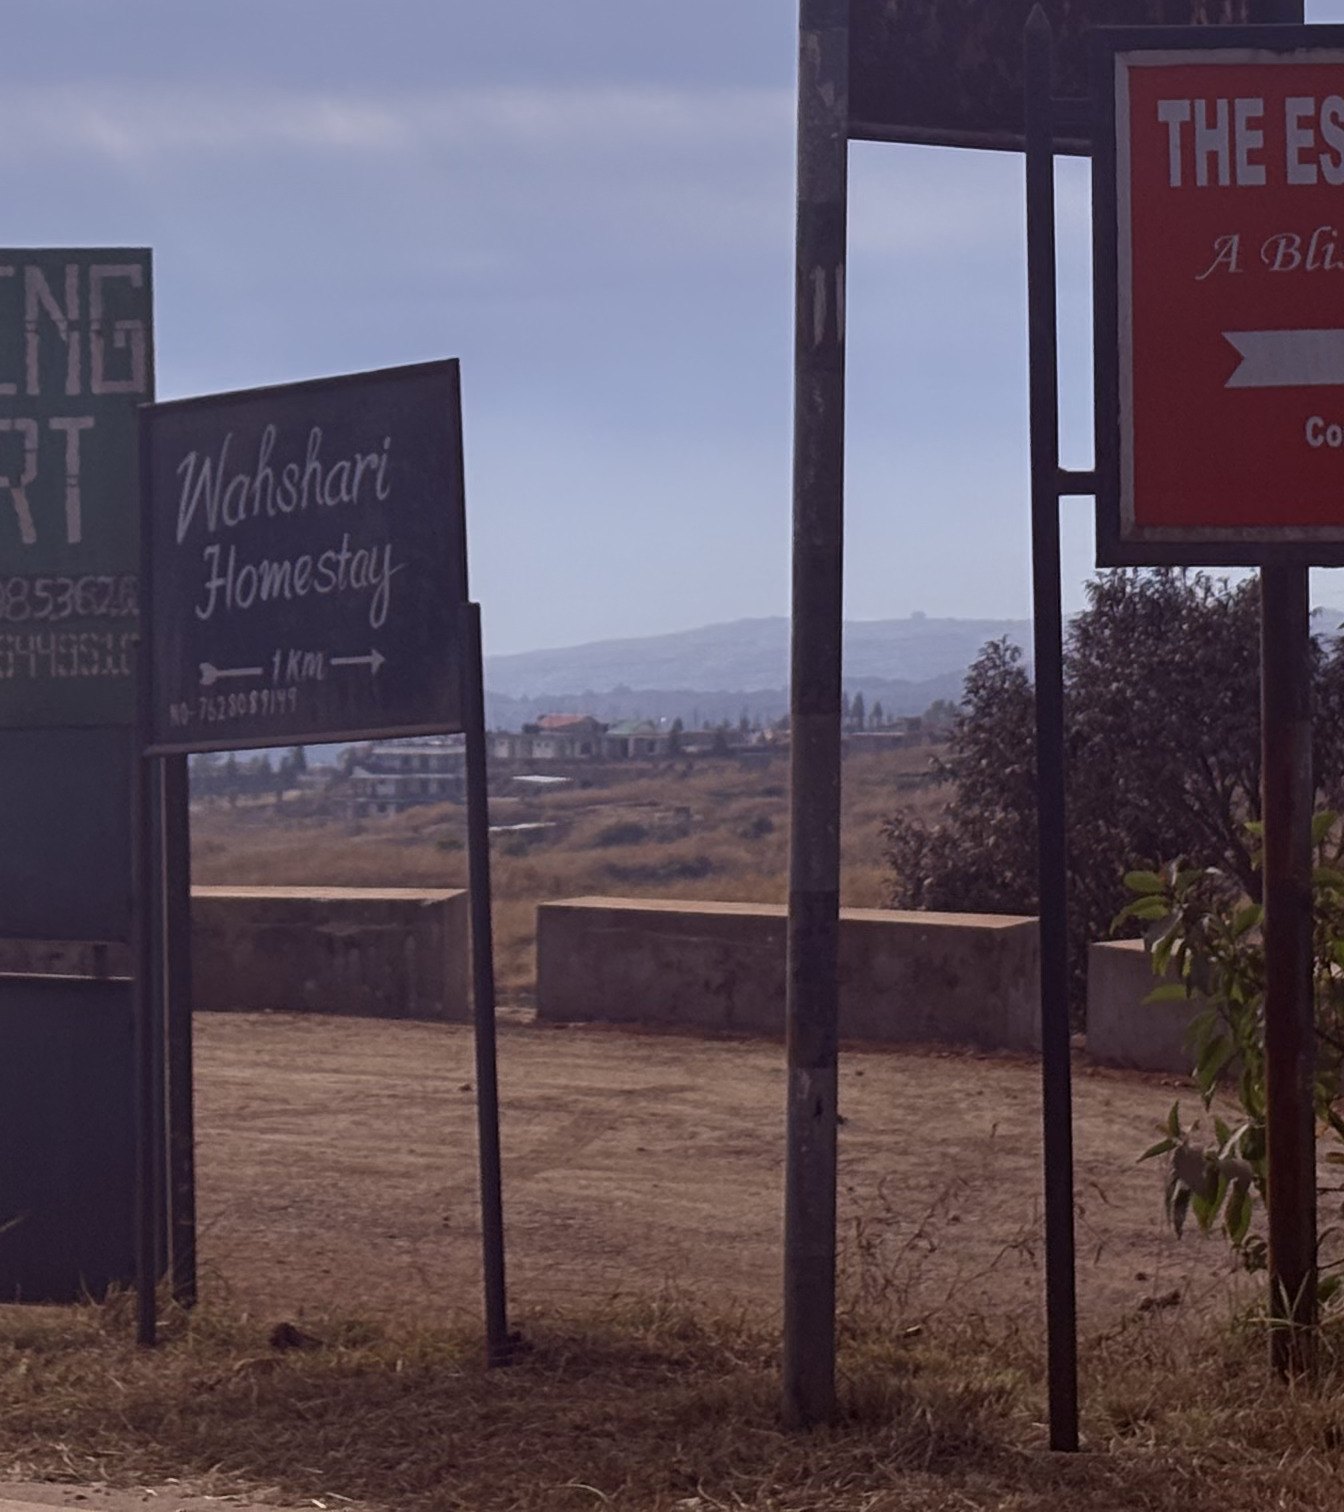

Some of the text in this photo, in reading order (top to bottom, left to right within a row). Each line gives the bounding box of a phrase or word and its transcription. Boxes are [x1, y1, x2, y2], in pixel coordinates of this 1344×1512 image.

[1158, 97, 1267, 187] THE
[1195, 233, 1244, 280] A
[176, 424, 391, 545] Wahshari
[195, 532, 406, 629] Homestay
